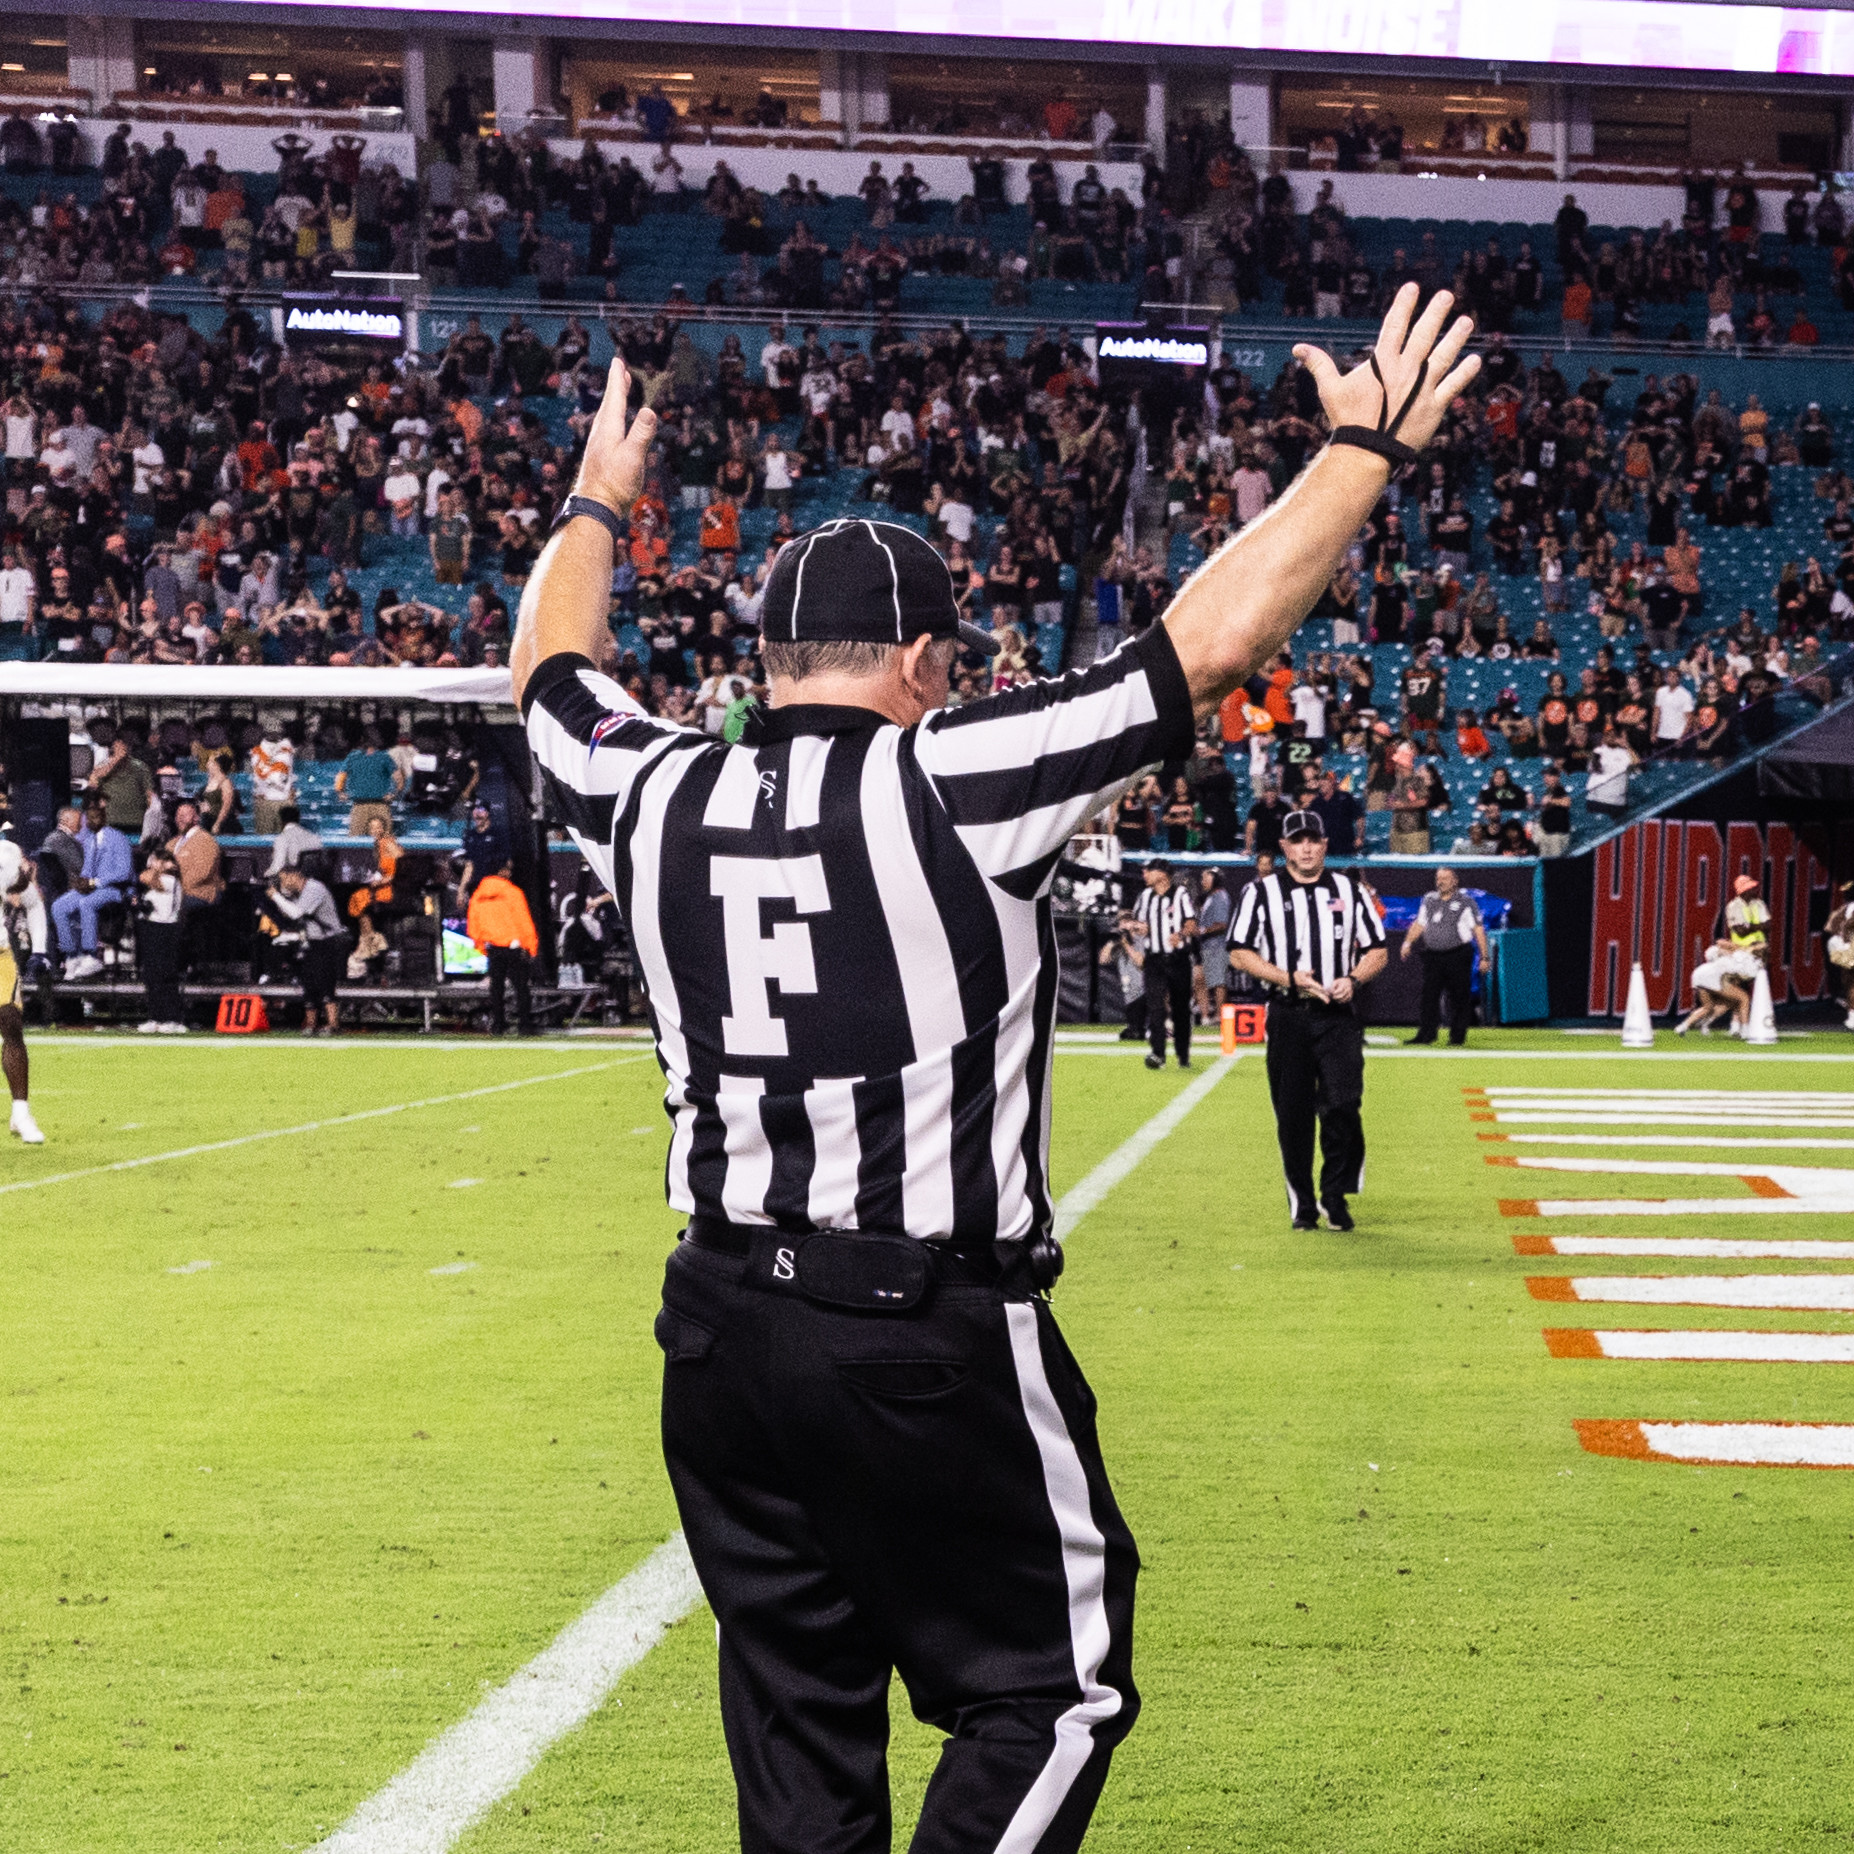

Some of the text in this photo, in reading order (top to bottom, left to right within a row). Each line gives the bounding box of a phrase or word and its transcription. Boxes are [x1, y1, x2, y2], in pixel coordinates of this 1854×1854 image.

[286, 308, 401, 333] AutoNation
[1099, 337, 1207, 360] AutoNation
[710, 853, 831, 1056] F
[224, 998, 251, 1027] 10
[1235, 1009, 1258, 1037] G
